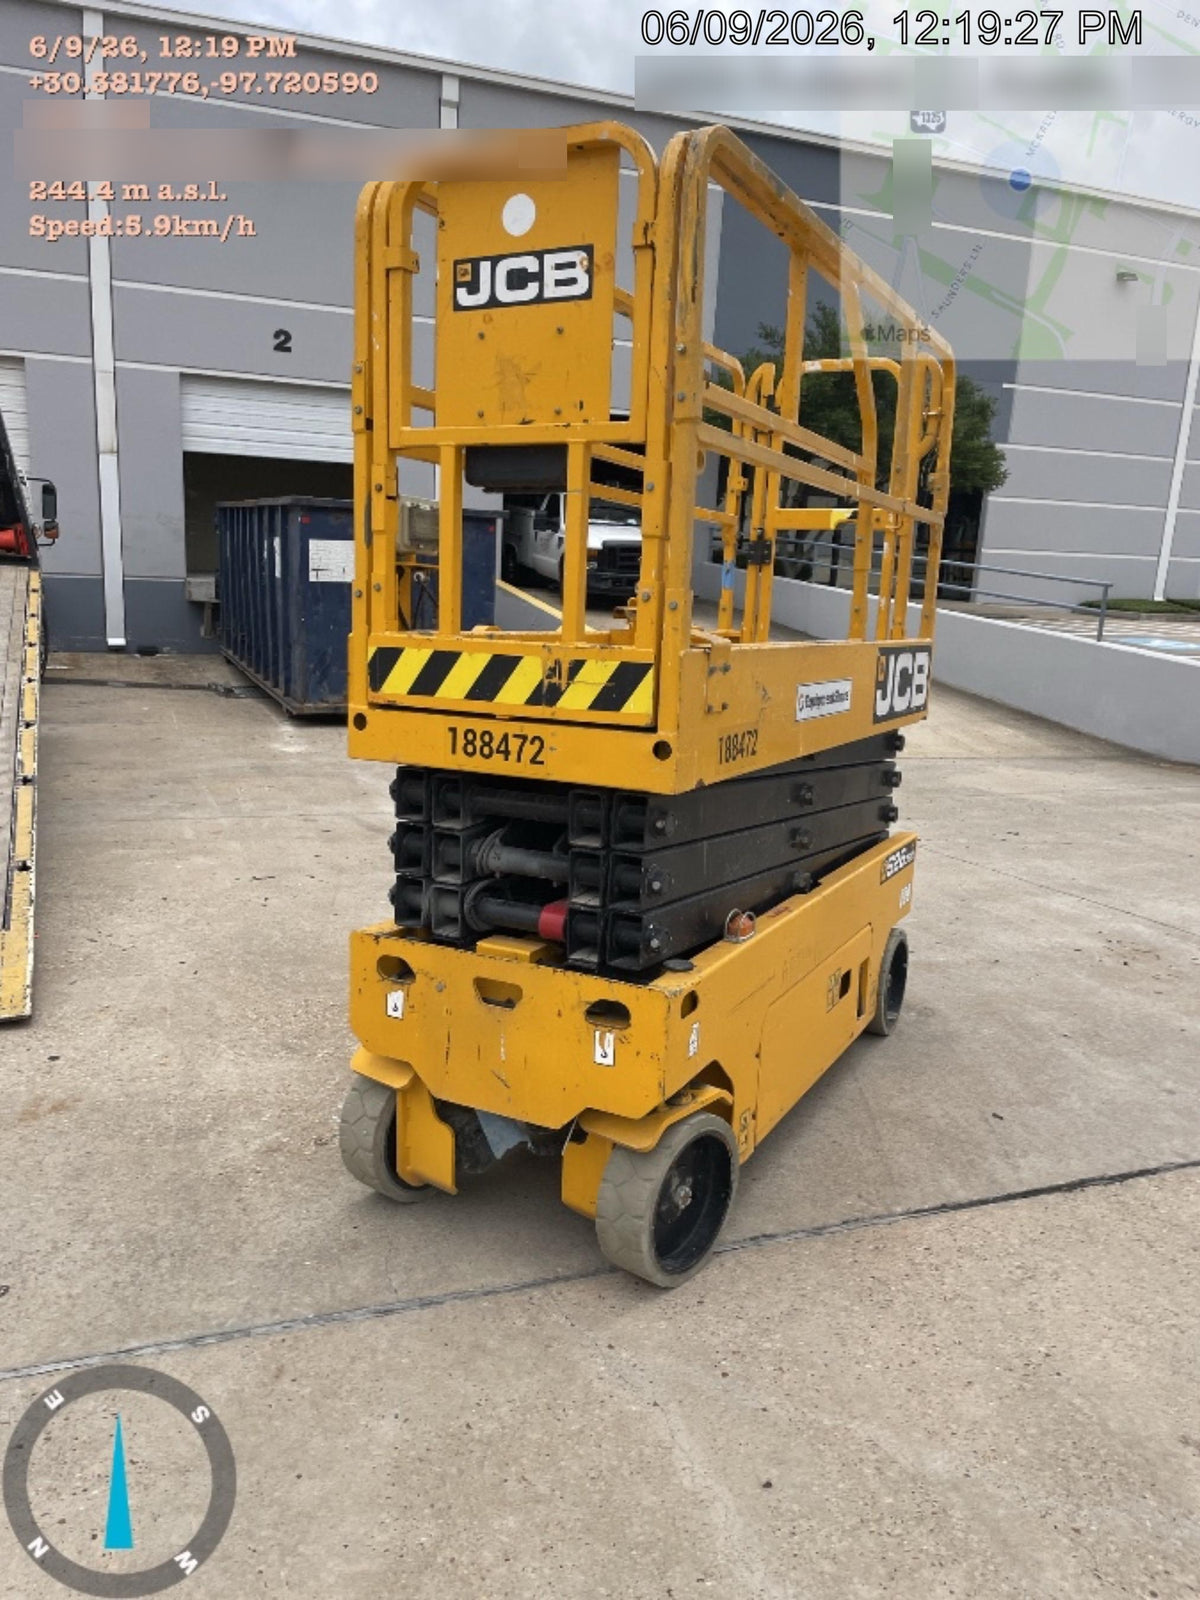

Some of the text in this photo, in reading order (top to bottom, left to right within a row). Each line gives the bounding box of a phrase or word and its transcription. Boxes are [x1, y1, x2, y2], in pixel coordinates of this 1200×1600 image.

[456, 250, 590, 307] JCB
[273, 328, 292, 353] 2
[876, 651, 929, 716] JCB
[447, 726, 546, 765] 188472
[718, 728, 758, 765] 188472
